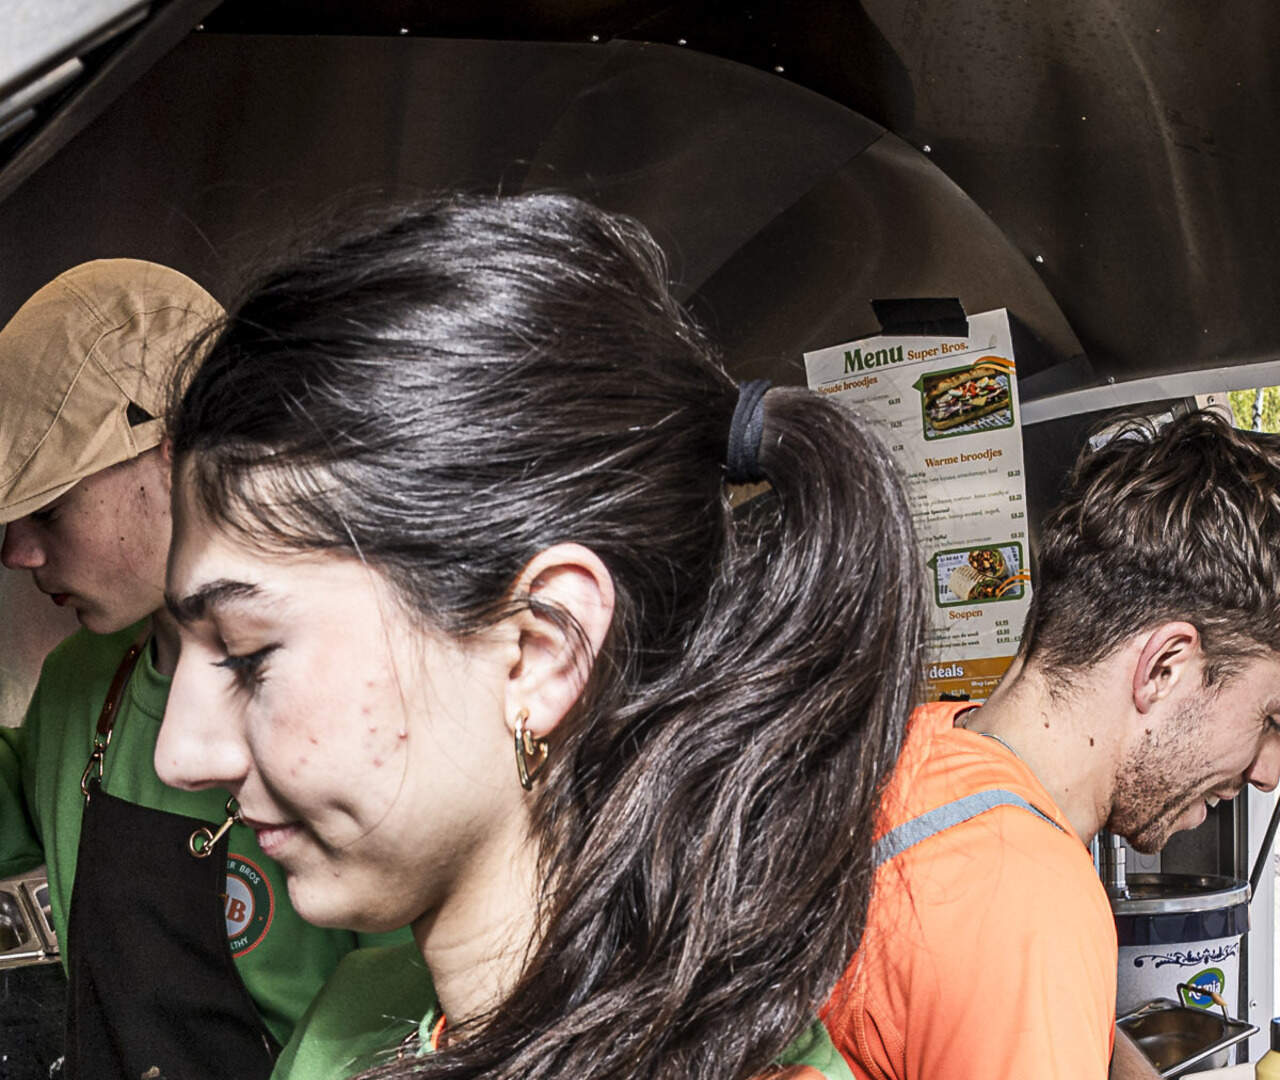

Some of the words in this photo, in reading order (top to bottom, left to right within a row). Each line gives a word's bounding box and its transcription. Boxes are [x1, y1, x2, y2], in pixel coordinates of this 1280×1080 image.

[844, 346, 904, 374] Menu
[907, 347, 939, 361] Super
[941, 342, 968, 354] Bros.
[925, 456, 958, 468] Warme
[960, 448, 1003, 462] broodjes
[949, 609, 983, 620] Soepen
[930, 664, 964, 678] deals
[240, 864, 262, 884] BROS
